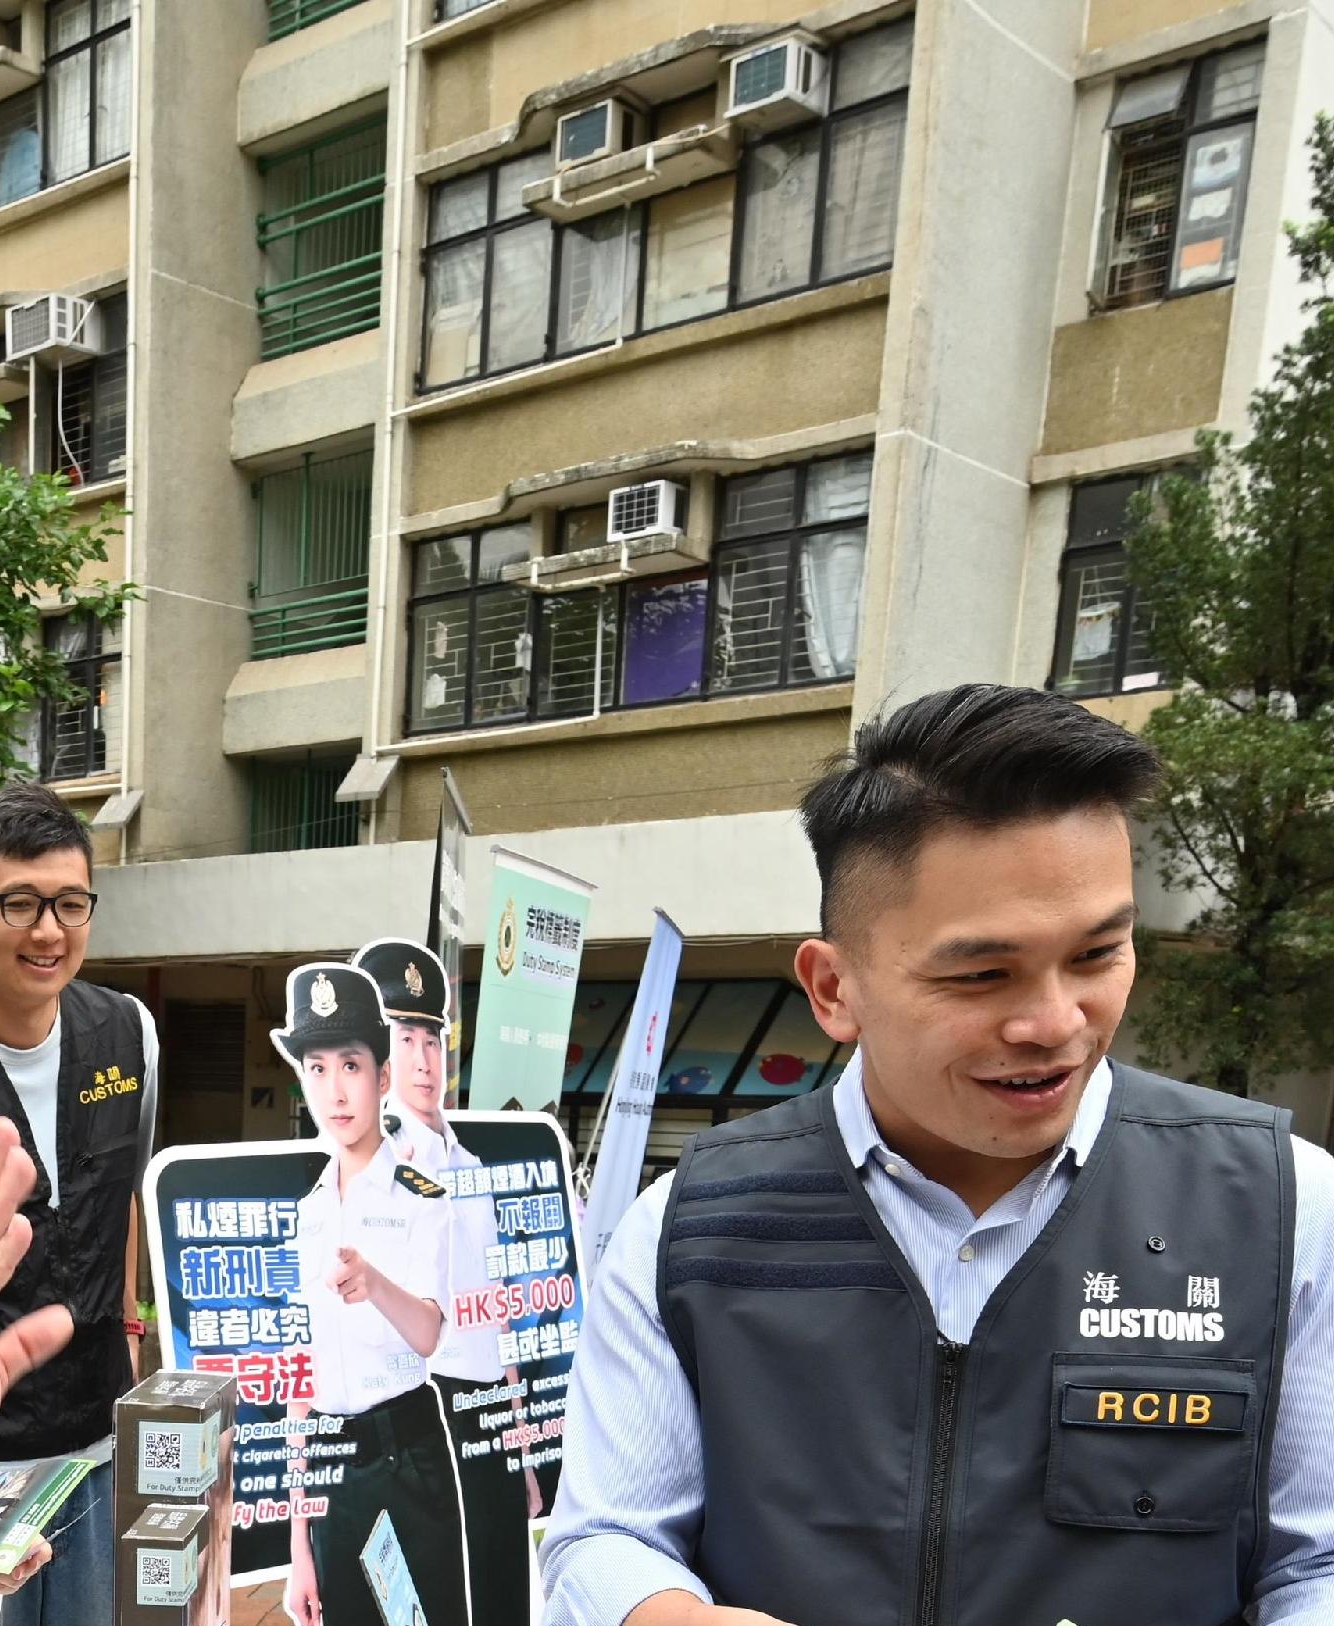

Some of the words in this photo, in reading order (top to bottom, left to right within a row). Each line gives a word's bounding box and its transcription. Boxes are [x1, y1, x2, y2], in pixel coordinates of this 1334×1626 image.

[80, 1077, 138, 1104] CUSTOMS
[175, 1201, 298, 1238] 私煙罪行
[182, 1248, 301, 1297] 新刑責
[189, 1305, 311, 1347] 違者必究
[1080, 1308, 1224, 1341] CUSTOMS
[453, 1379, 527, 1411] Undeclared
[1098, 1392, 1211, 1425] RCIB
[241, 1418, 316, 1444] penalties
[319, 1415, 344, 1434] for
[479, 1411, 513, 1431] liquor
[515, 1407, 528, 1419] or
[241, 1446, 299, 1464] cigarette
[301, 1442, 357, 1457] offences
[462, 1441, 490, 1459] from
[493, 1437, 501, 1451] a
[240, 1475, 276, 1492] one
[281, 1465, 344, 1489] should
[507, 1457, 520, 1473] to
[147, 1483, 157, 1491] For
[160, 1484, 176, 1493] Duty
[258, 1499, 290, 1522] the
[293, 1498, 328, 1519] law
